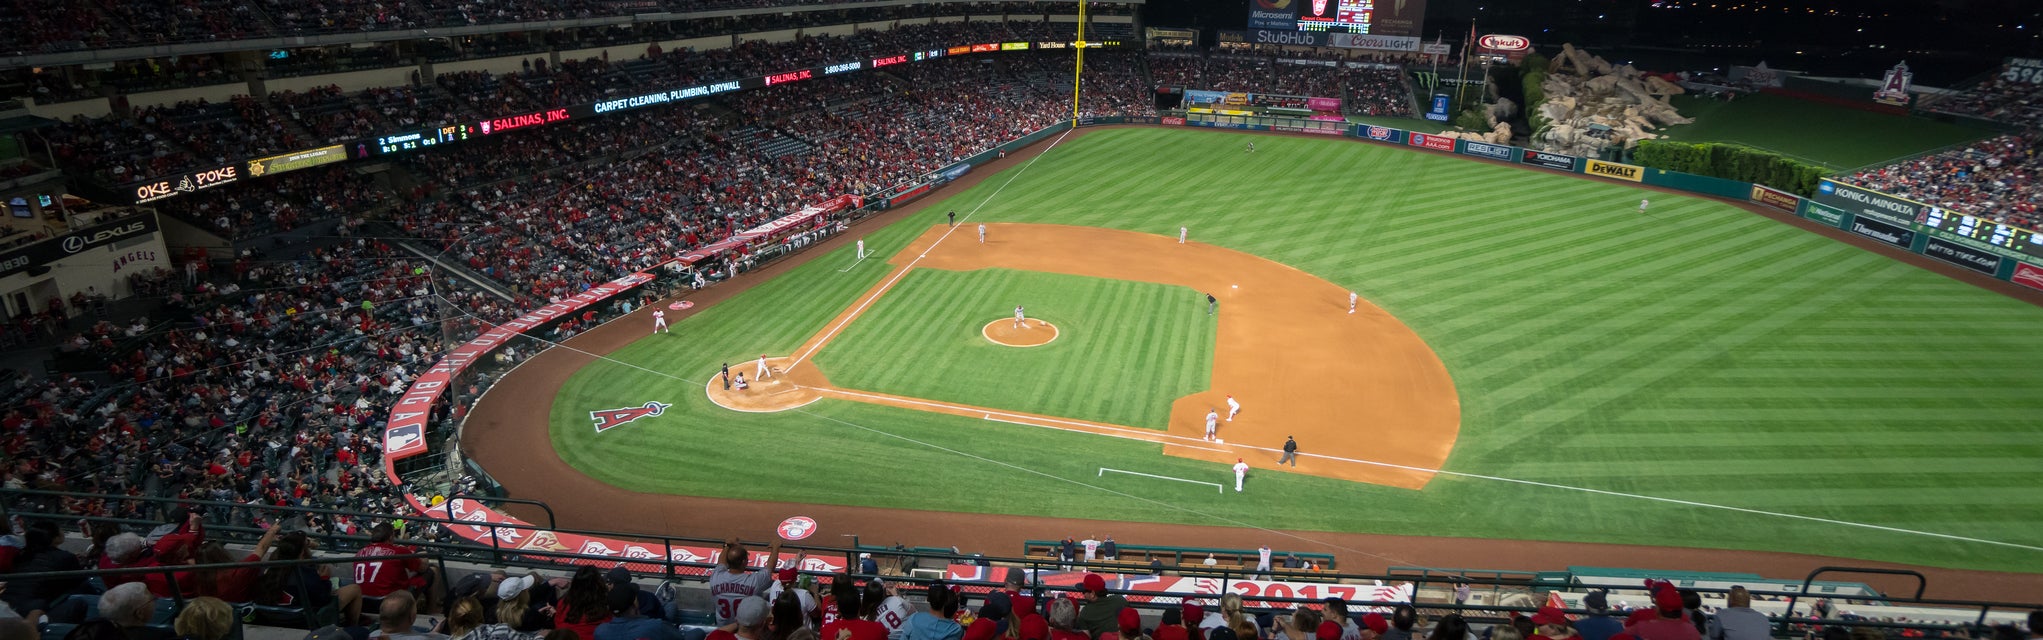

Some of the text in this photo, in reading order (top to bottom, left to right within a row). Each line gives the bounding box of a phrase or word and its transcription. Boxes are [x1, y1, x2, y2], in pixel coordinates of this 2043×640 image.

[1252, 10, 1293, 19] Microsemi
[1257, 29, 1315, 45] StubHub
[1352, 34, 1384, 48] Coors
[1385, 39, 1414, 49] LIGHT
[877, 57, 897, 66] SALINAS,
[771, 70, 812, 84] SALINAS, INC.
[595, 80, 741, 113] CARPET CLEANING, PLUMBING, DRYWALL
[493, 108, 570, 131] SALINAS, INC.
[1162, 117, 1183, 125] Coca-Cola
[388, 133, 421, 144] Simmons
[442, 126, 456, 135] DET
[1537, 153, 1571, 164] YOKOHAMA
[137, 181, 171, 199] OKE
[195, 166, 237, 185] POKE
[1764, 191, 1797, 206] PECHANGA
[1834, 187, 1914, 216] KONICA MINOLTA
[1815, 207, 1842, 220] National
[83, 221, 145, 245] LEXUS
[1853, 222, 1900, 244] Thermador
[113, 251, 155, 273] ANGELS
[393, 286, 617, 423] WELCOME TO THE BIG A
[355, 561, 383, 584] 07
[1232, 581, 1357, 612] 2017
